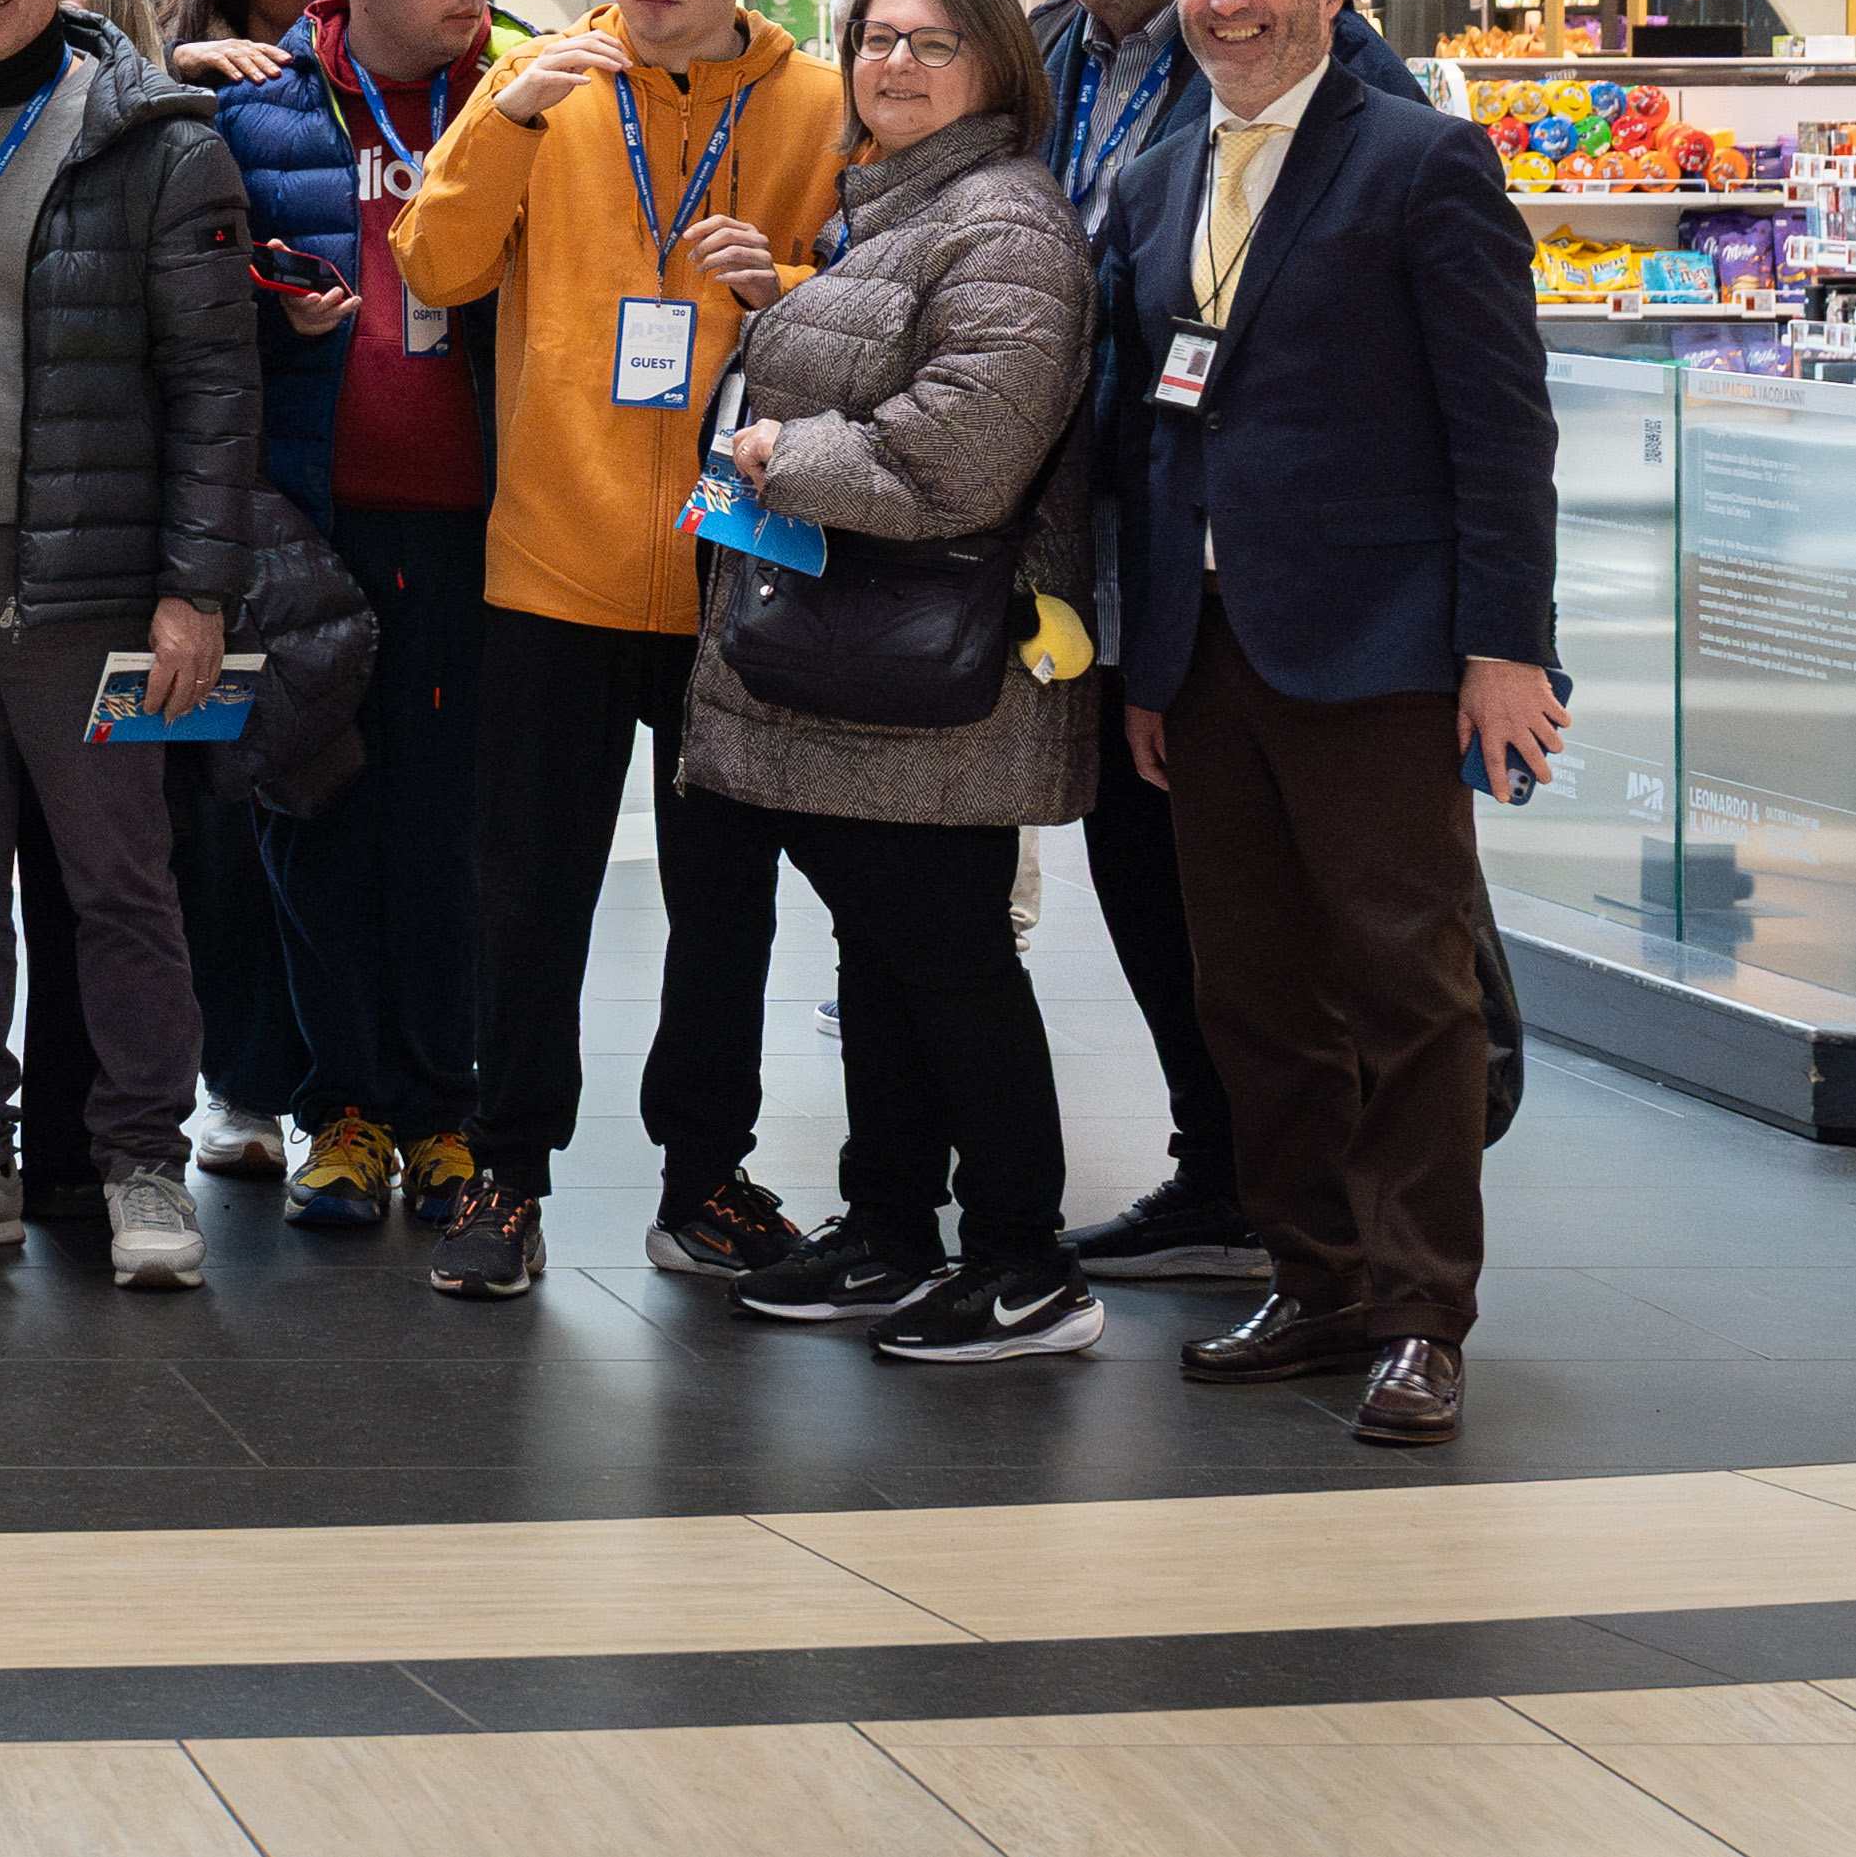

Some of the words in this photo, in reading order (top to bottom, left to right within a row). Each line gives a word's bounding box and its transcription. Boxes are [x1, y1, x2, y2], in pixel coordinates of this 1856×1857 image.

[625, 122, 637, 146] ADR
[708, 130, 726, 155] ADR
[413, 309, 443, 321] OSPITE
[672, 309, 686, 317] 120
[630, 356, 677, 370] GUEST
[1627, 771, 1665, 811] ADR
[1689, 786, 1748, 820] LEONARDO
[1751, 801, 1760, 824] &
[1689, 810, 1699, 832] IL
[1701, 813, 1749, 845] VIAGGIO
